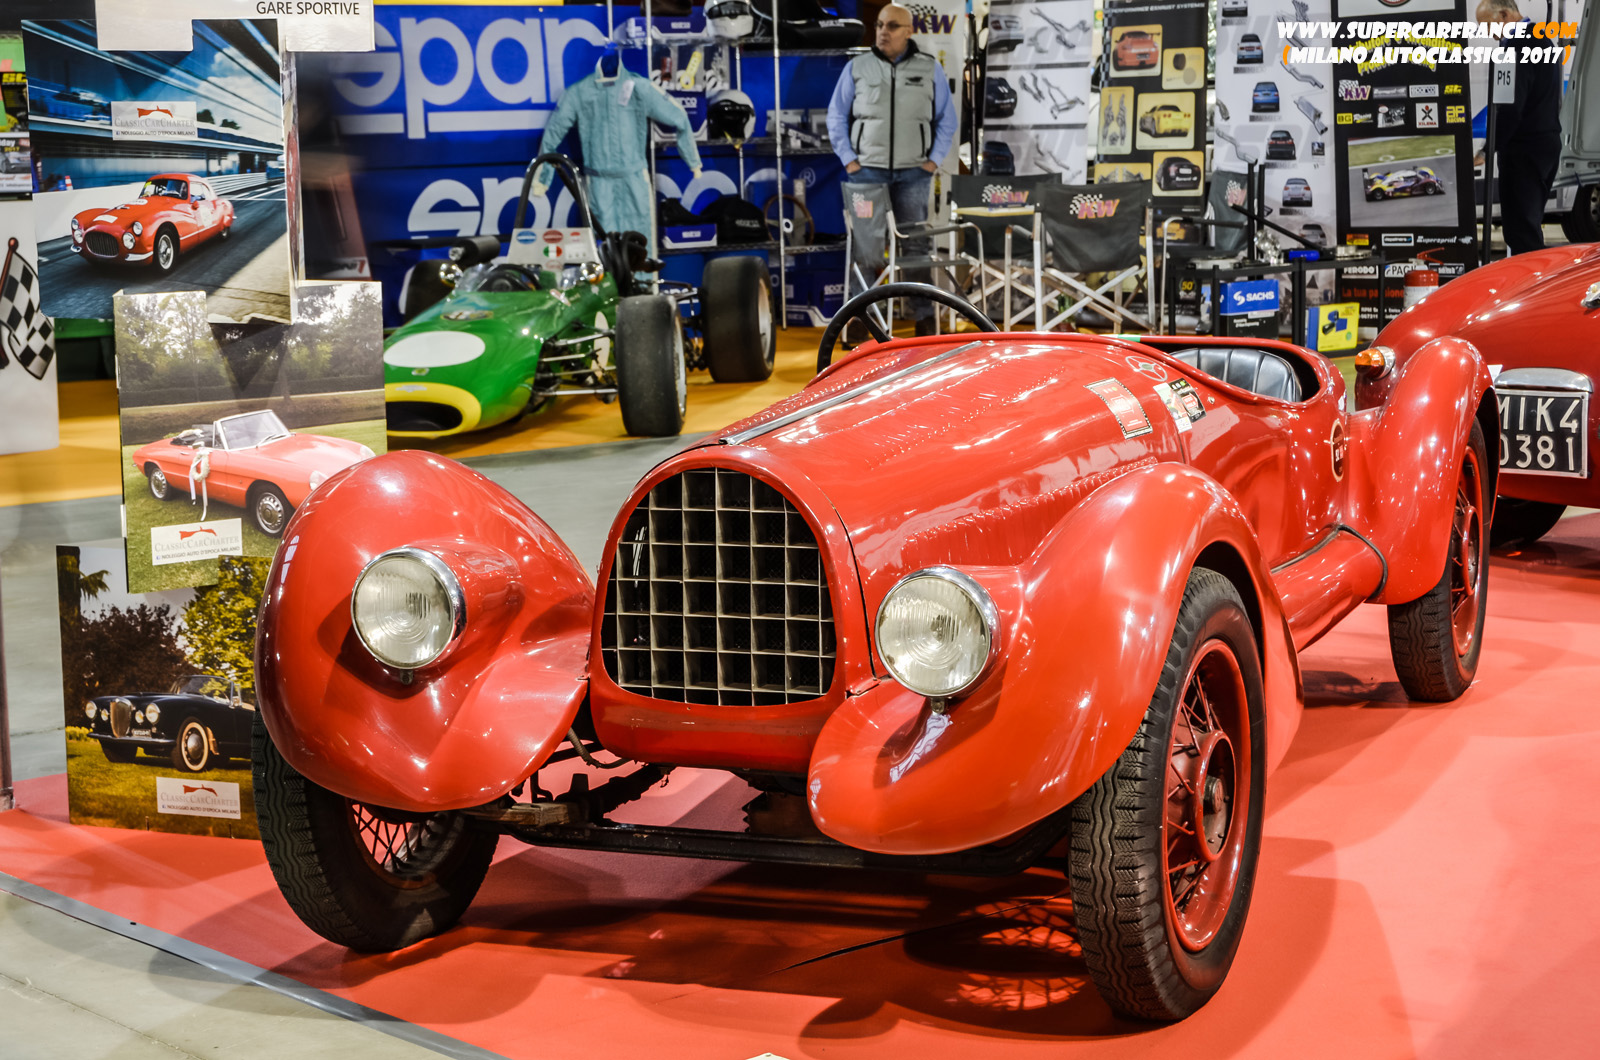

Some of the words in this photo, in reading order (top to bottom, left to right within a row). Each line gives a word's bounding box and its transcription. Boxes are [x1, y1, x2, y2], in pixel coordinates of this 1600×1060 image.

[256, 2, 292, 14] GARE
[296, 2, 360, 15] SPORTIVE
[912, 14, 957, 34] KW
[330, 17, 612, 138] spar
[1497, 70, 1511, 86] P15
[1344, 85, 1371, 100] KW
[990, 191, 1029, 203] KW
[1078, 199, 1120, 219] KW
[1343, 265, 1375, 274] FERODO
[1246, 291, 1275, 302] SACHS
